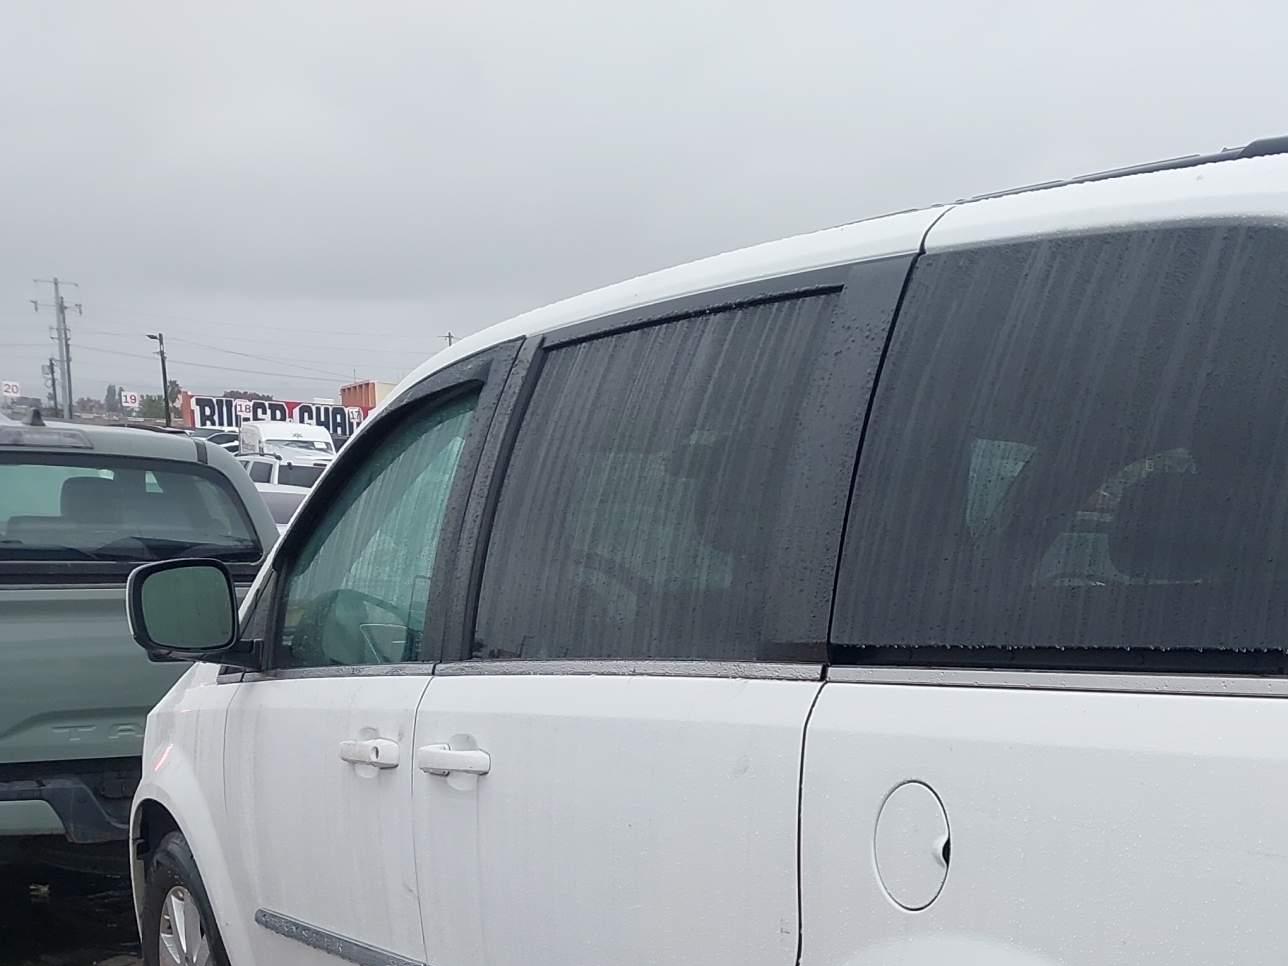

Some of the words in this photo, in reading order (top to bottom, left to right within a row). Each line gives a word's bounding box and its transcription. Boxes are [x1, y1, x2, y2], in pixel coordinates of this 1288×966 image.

[3, 383, 19, 394] 20
[122, 394, 137, 404] 19
[237, 403, 251, 414] 18
[350, 410, 361, 420] 17
